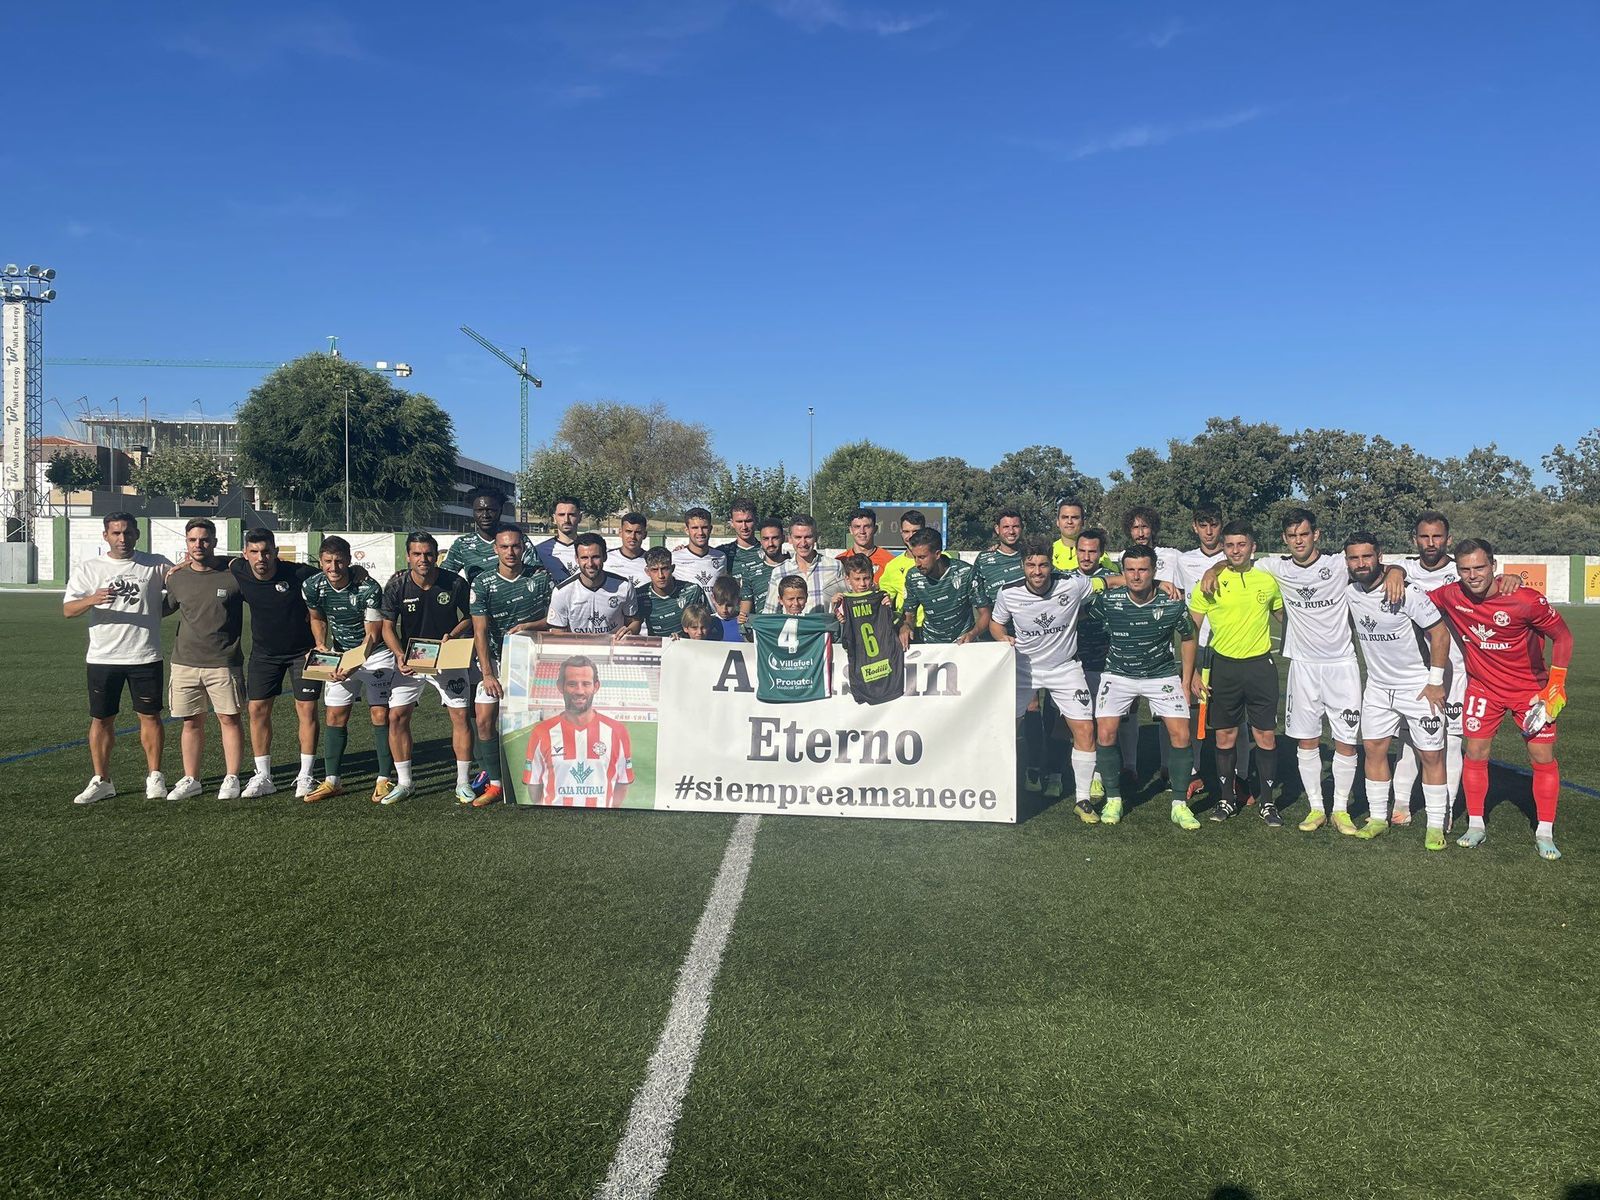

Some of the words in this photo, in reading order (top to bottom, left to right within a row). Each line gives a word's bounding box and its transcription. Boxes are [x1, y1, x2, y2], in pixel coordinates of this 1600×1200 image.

[12, 306, 20, 330] Energy
[12, 366, 20, 390] Energy
[12, 427, 20, 451] Energy
[852, 604, 873, 618] IVÁN
[1305, 599, 1337, 609] RURAL
[594, 622, 618, 633] RURAL
[1043, 623, 1070, 636] RURAL
[778, 618, 799, 654] 4
[861, 622, 880, 658] 6
[1369, 632, 1400, 642] RURAL
[1480, 641, 1512, 650] RURAL
[780, 658, 813, 667] Villafuel
[775, 678, 813, 686] Pronatal
[1101, 681, 1112, 696] 5
[1466, 695, 1488, 718] 13
[747, 717, 923, 766] Eterno
[576, 785, 605, 795] RURAL
[675, 775, 997, 810] #siempreamanece
